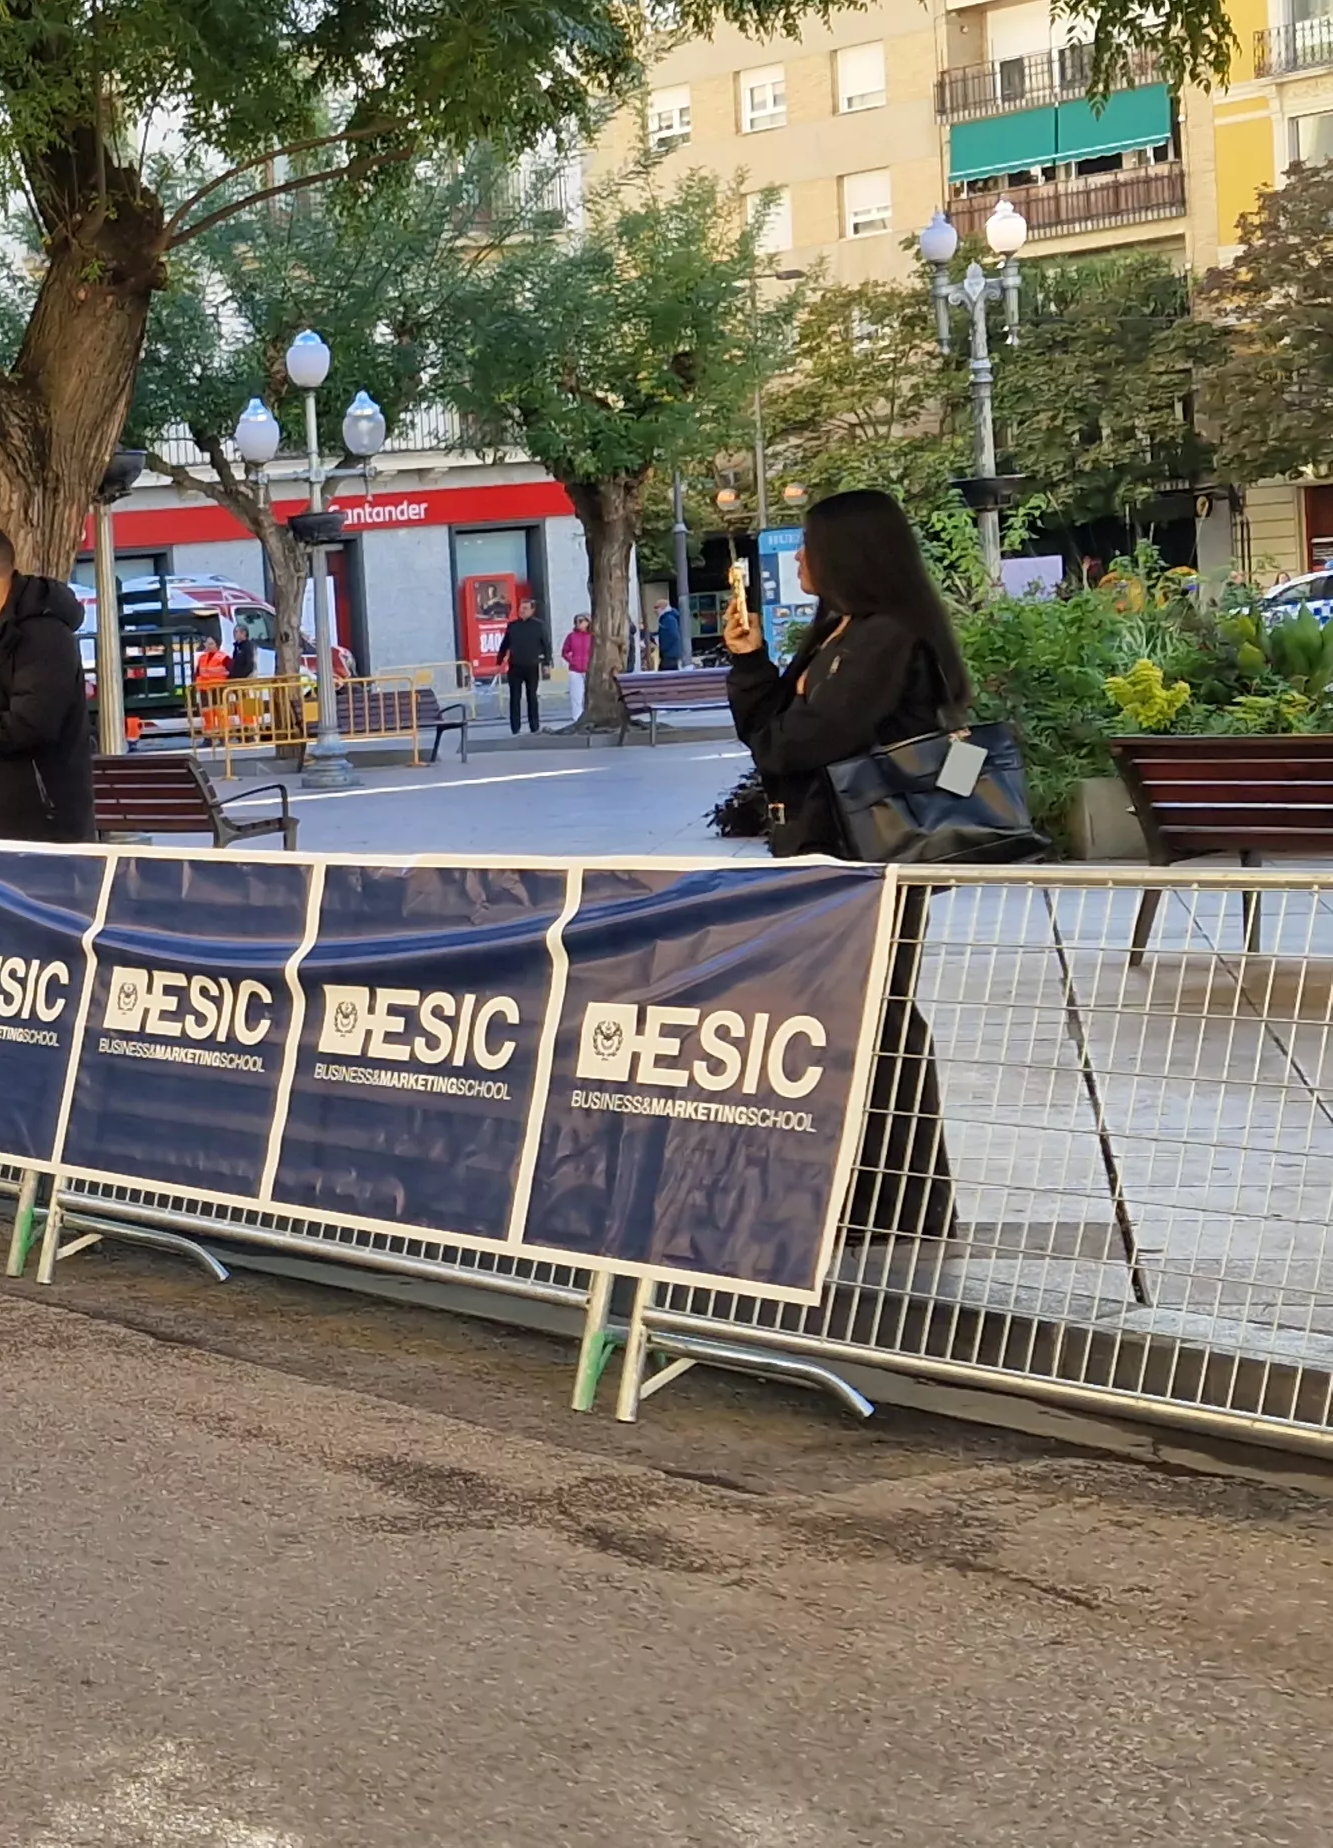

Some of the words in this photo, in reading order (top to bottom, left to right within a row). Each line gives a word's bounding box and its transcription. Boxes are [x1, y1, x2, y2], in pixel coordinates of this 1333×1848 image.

[145, 969, 273, 1047] ESIC
[366, 986, 521, 1072] ESIC
[635, 1005, 828, 1099] ESIC
